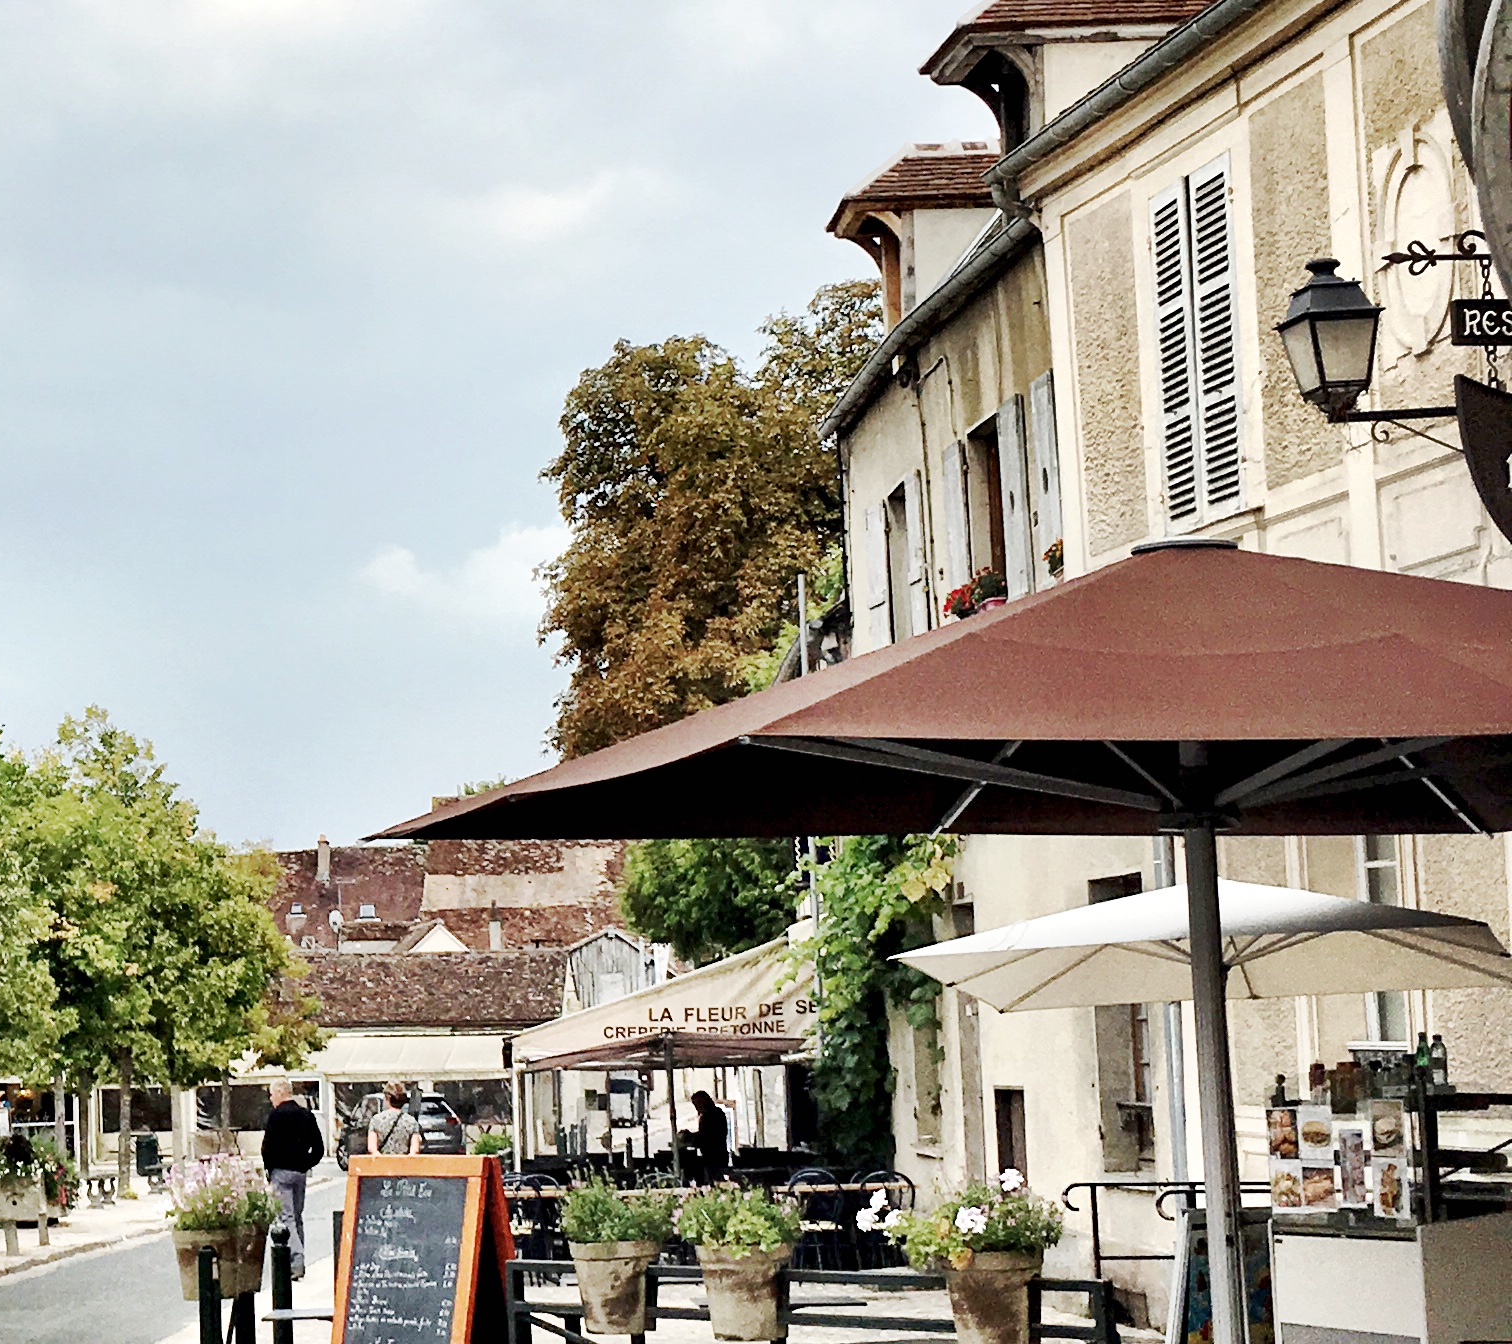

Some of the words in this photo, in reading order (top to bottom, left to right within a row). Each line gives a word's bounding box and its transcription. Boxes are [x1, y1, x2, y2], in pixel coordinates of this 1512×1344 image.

[1463, 308, 1512, 336] RES
[648, 1007, 673, 1023] LA
[684, 1006, 747, 1023] FLEUR
[758, 1001, 784, 1018] DE
